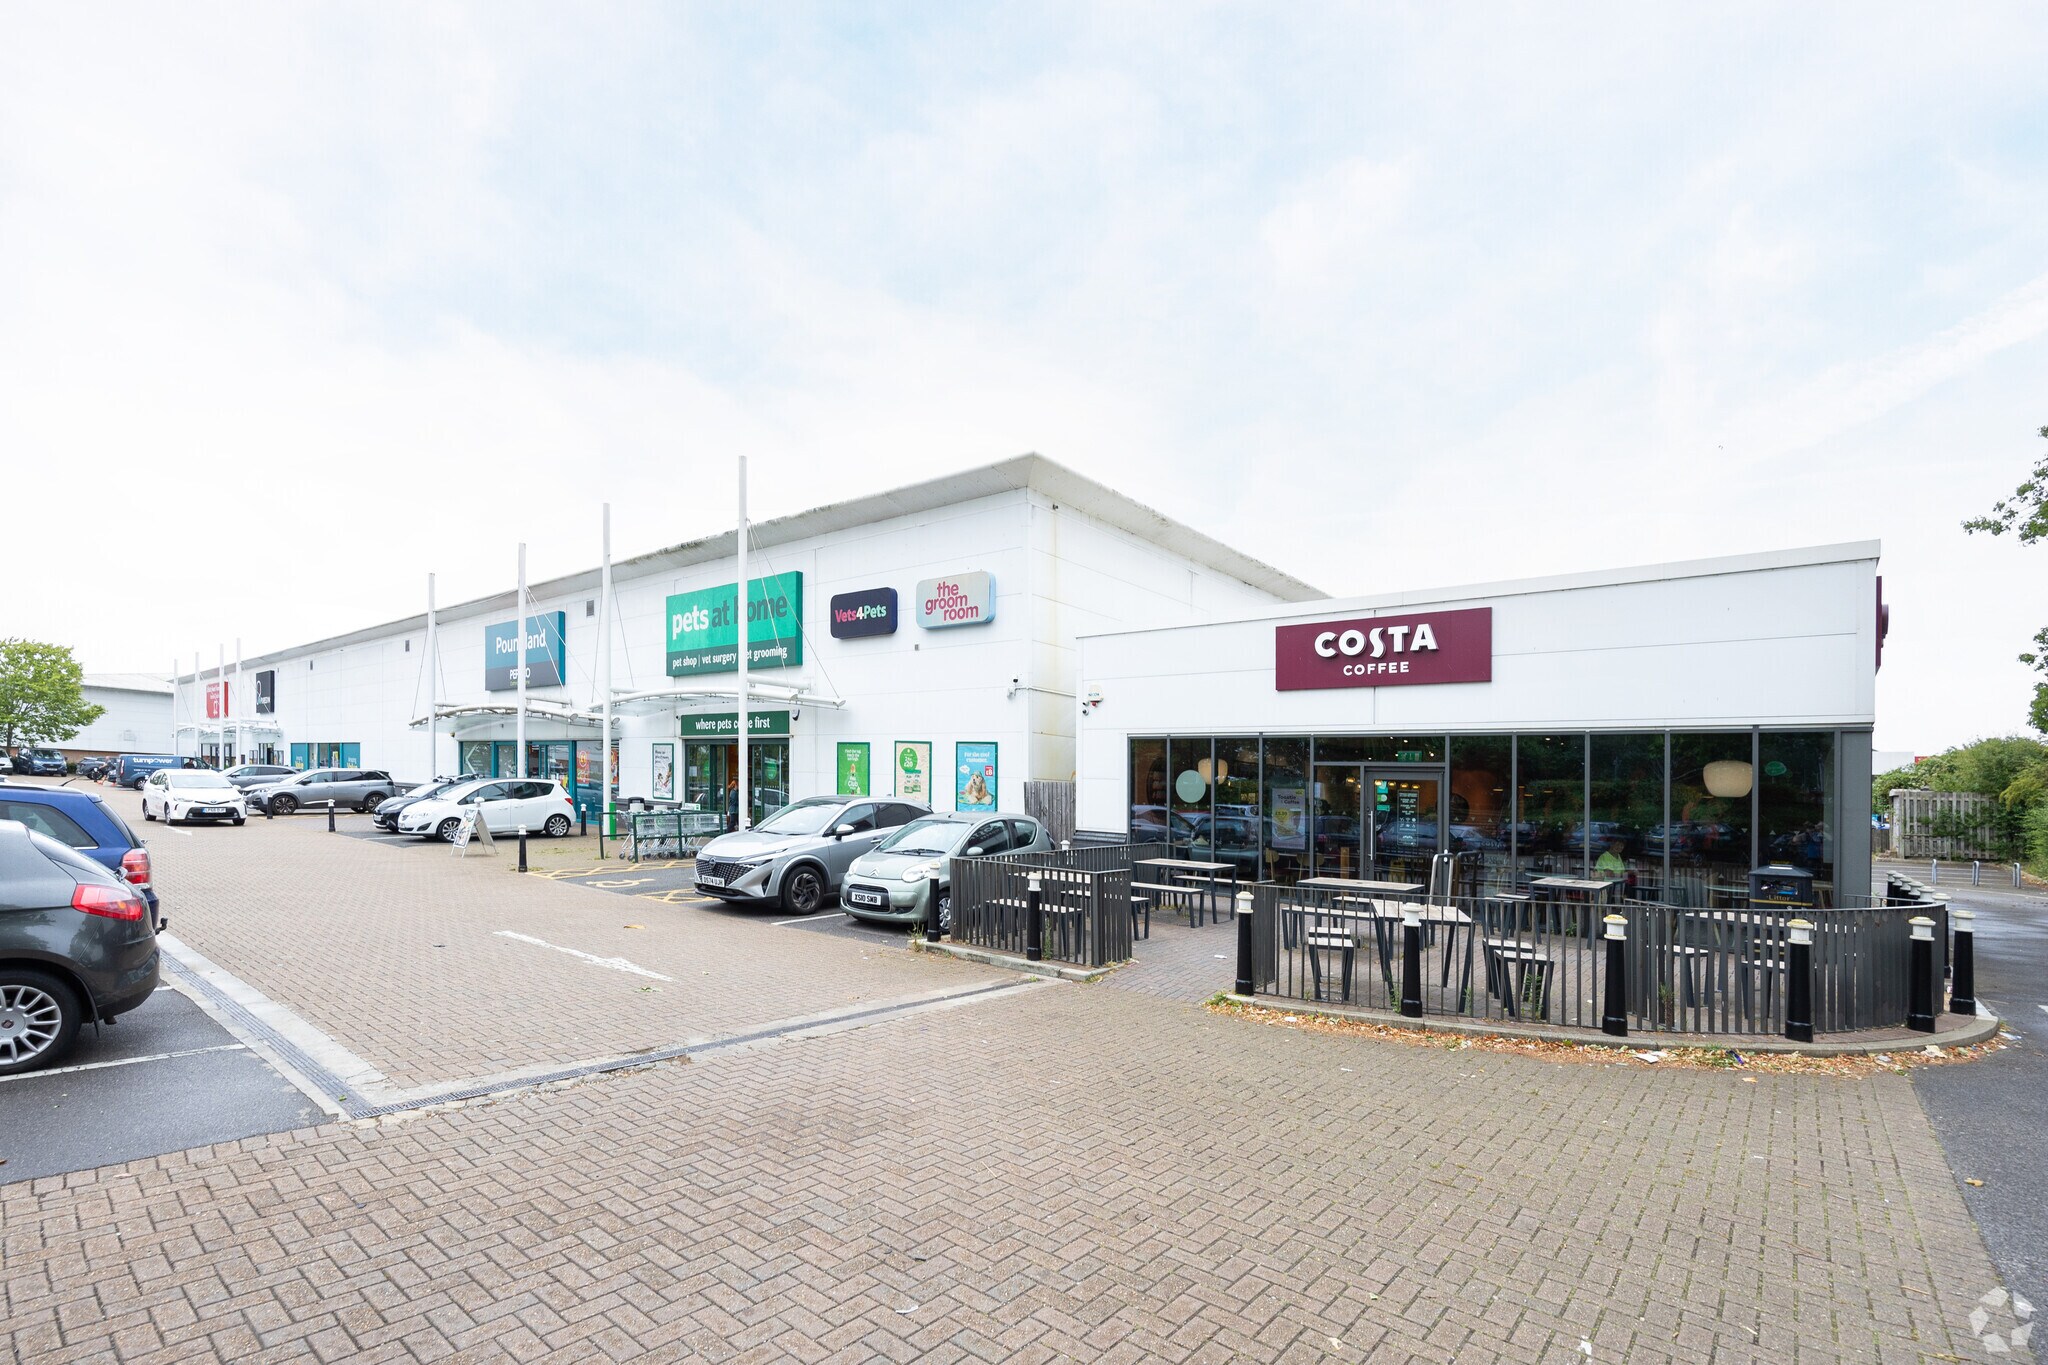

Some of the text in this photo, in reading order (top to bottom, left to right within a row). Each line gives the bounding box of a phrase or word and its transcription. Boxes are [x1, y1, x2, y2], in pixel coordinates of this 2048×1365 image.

[937, 582, 959, 597] the
[835, 605, 887, 623] Vets4Pets
[925, 595, 967, 615] groom
[943, 605, 978, 621] room
[672, 605, 709, 640] pets
[711, 600, 729, 628] at
[496, 628, 546, 654] Pounland
[1314, 623, 1439, 658] COSTA
[672, 657, 682, 669] pet
[683, 656, 697, 667] shop
[702, 655, 711, 664] vet
[712, 653, 736, 665] surgery
[754, 645, 787, 661] grooming
[1343, 661, 1410, 676] COFFEE
[695, 716, 770, 732] where pets ce first
